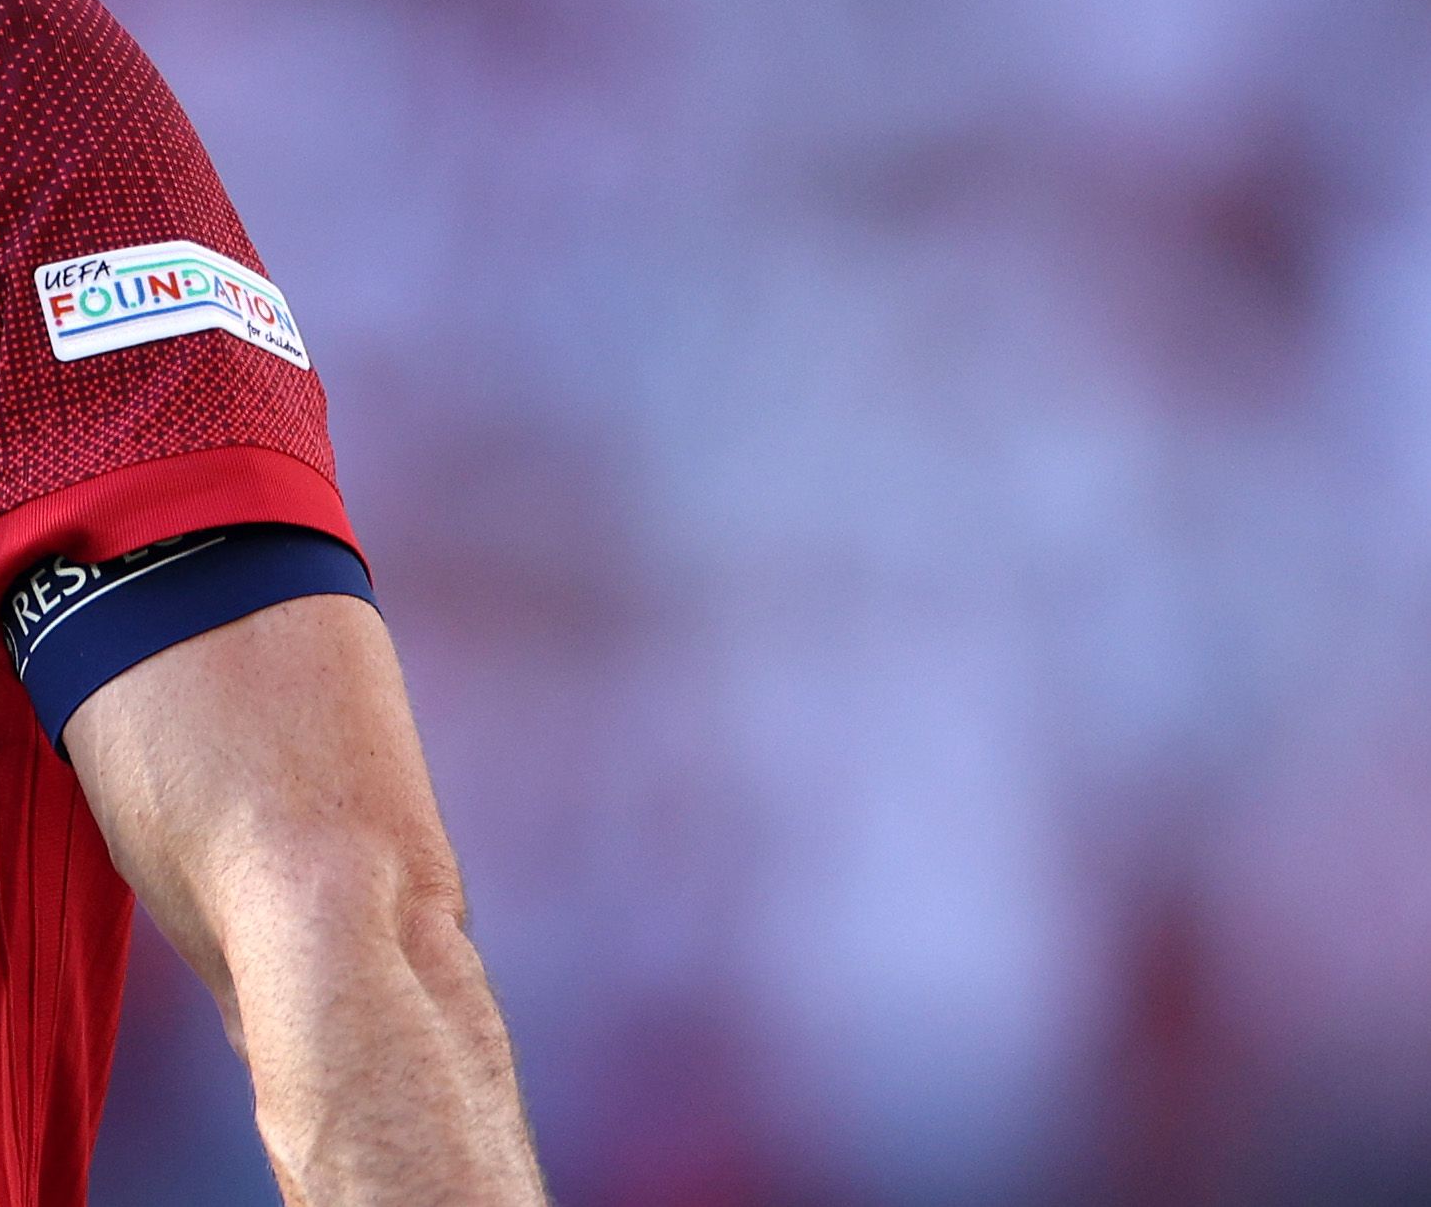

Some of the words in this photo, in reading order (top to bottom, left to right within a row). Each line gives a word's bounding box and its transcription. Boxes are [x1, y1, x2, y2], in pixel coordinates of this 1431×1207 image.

[44, 259, 111, 291] UEFA
[49, 268, 295, 337] FOUNDATION
[247, 319, 261, 339] for
[265, 330, 304, 360] children
